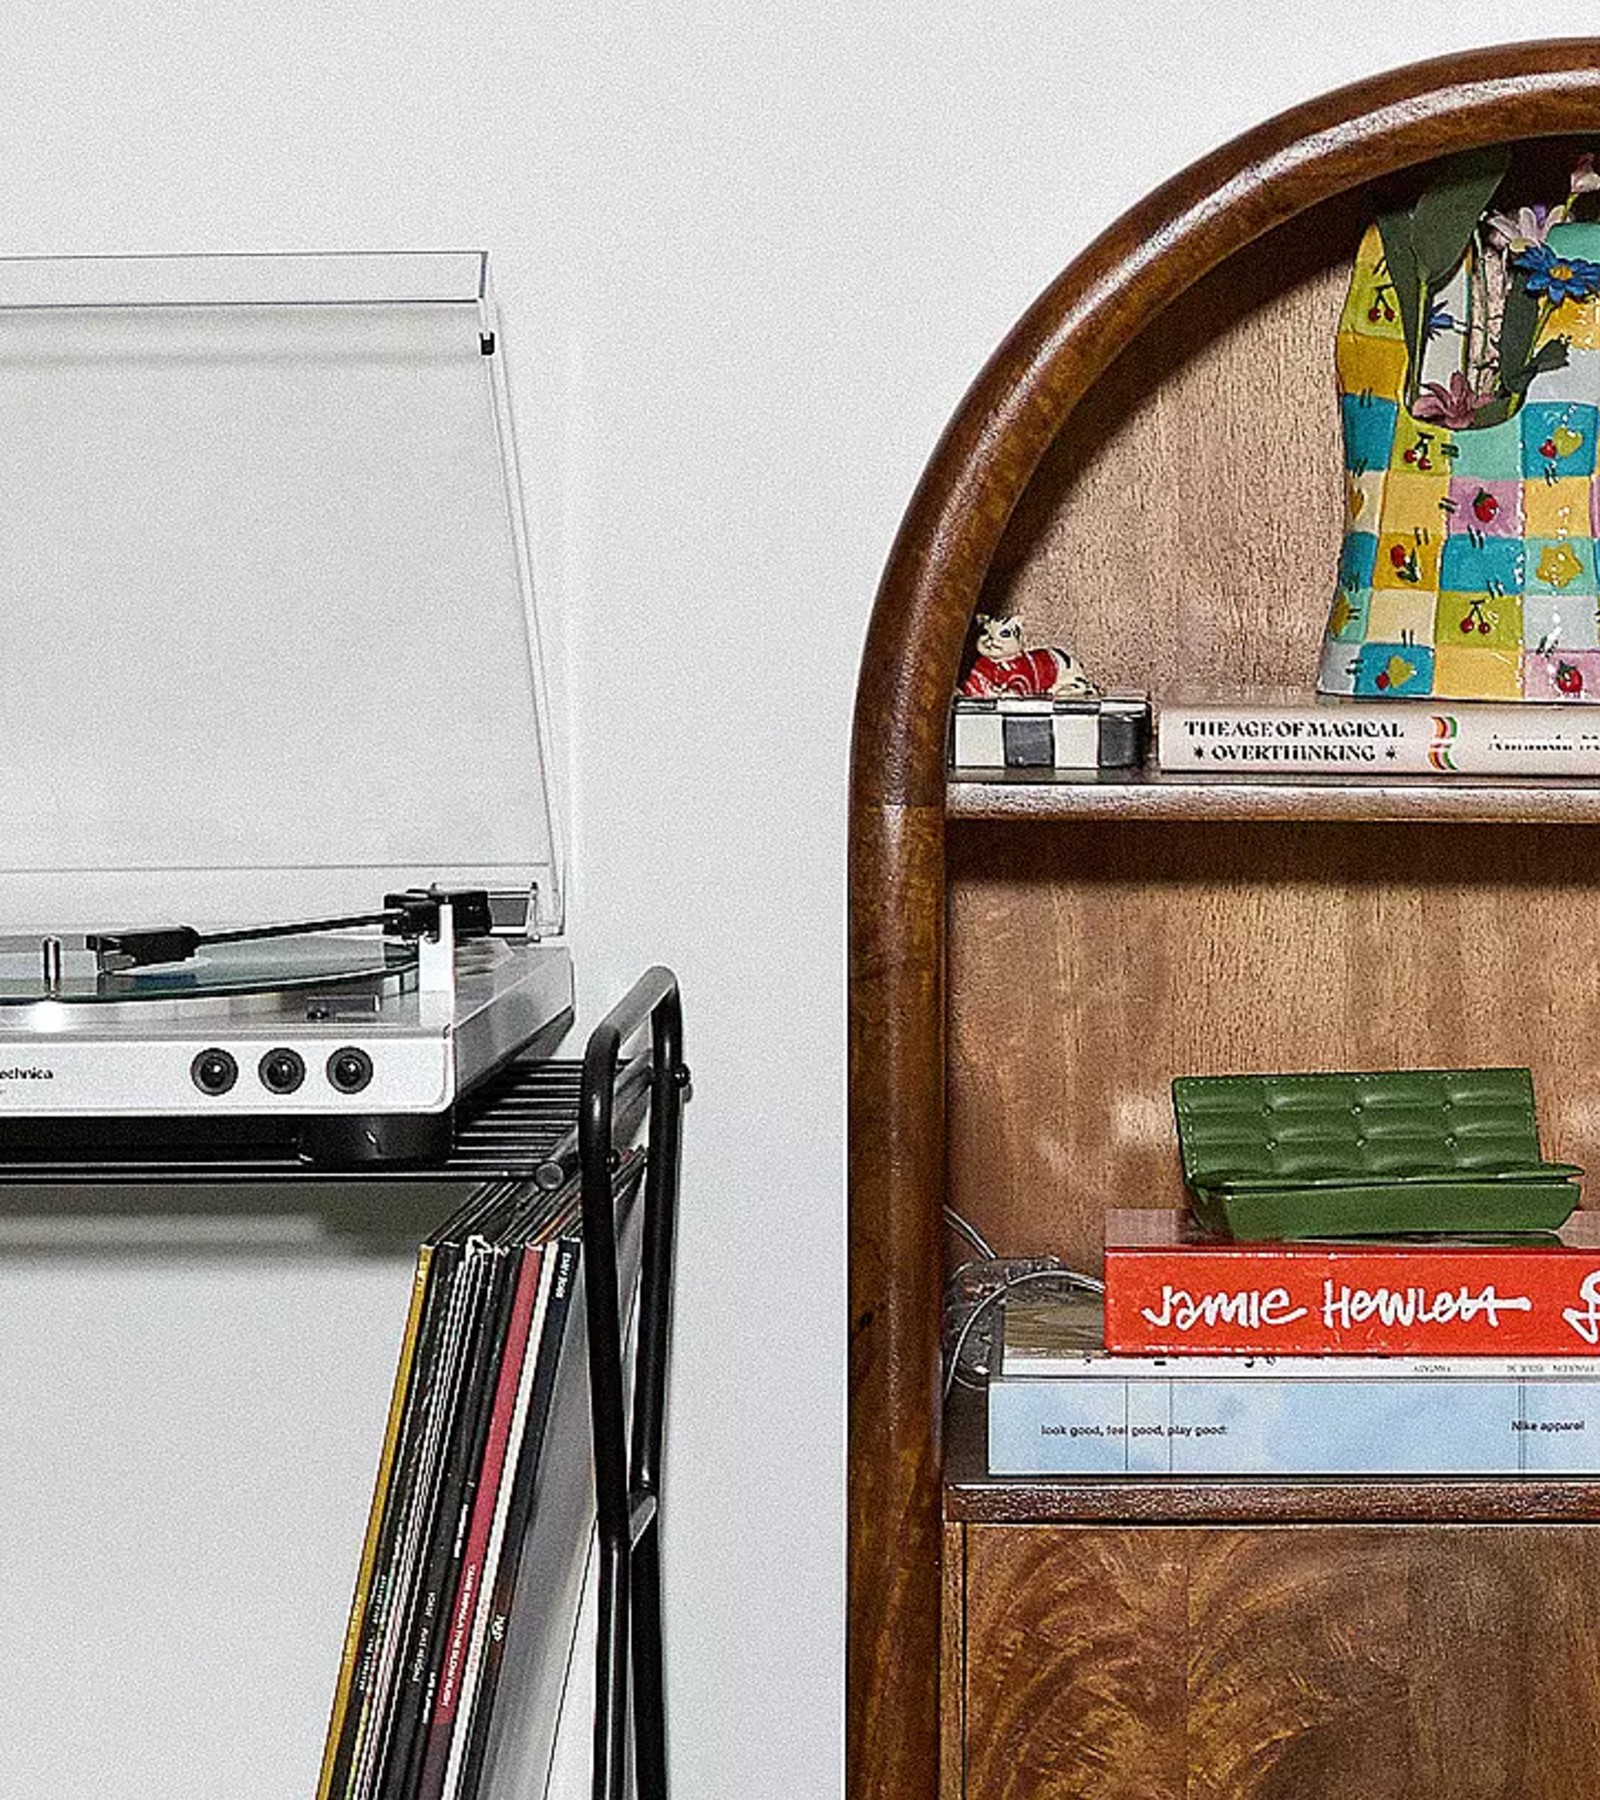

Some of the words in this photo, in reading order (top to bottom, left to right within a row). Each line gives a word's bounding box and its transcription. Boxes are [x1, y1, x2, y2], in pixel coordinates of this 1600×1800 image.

[1185, 721, 1230, 737] THE
[1231, 721, 1273, 737] AGE
[1275, 721, 1306, 737] OF
[1307, 721, 1405, 738] MAGICAL
[1211, 745, 1376, 761] OVERTHINKING
[0, 1067, 54, 1080] echnica
[1141, 1284, 1308, 1331] Jamie
[1320, 1279, 1532, 1330] Hewlett
[1041, 1424, 1067, 1435] look
[1070, 1424, 1104, 1437] good,
[1106, 1424, 1128, 1435] feel
[1131, 1424, 1164, 1437] good,
[1167, 1424, 1192, 1437] play
[1511, 1420, 1537, 1431] Nike
[1540, 1420, 1585, 1433] apparel
